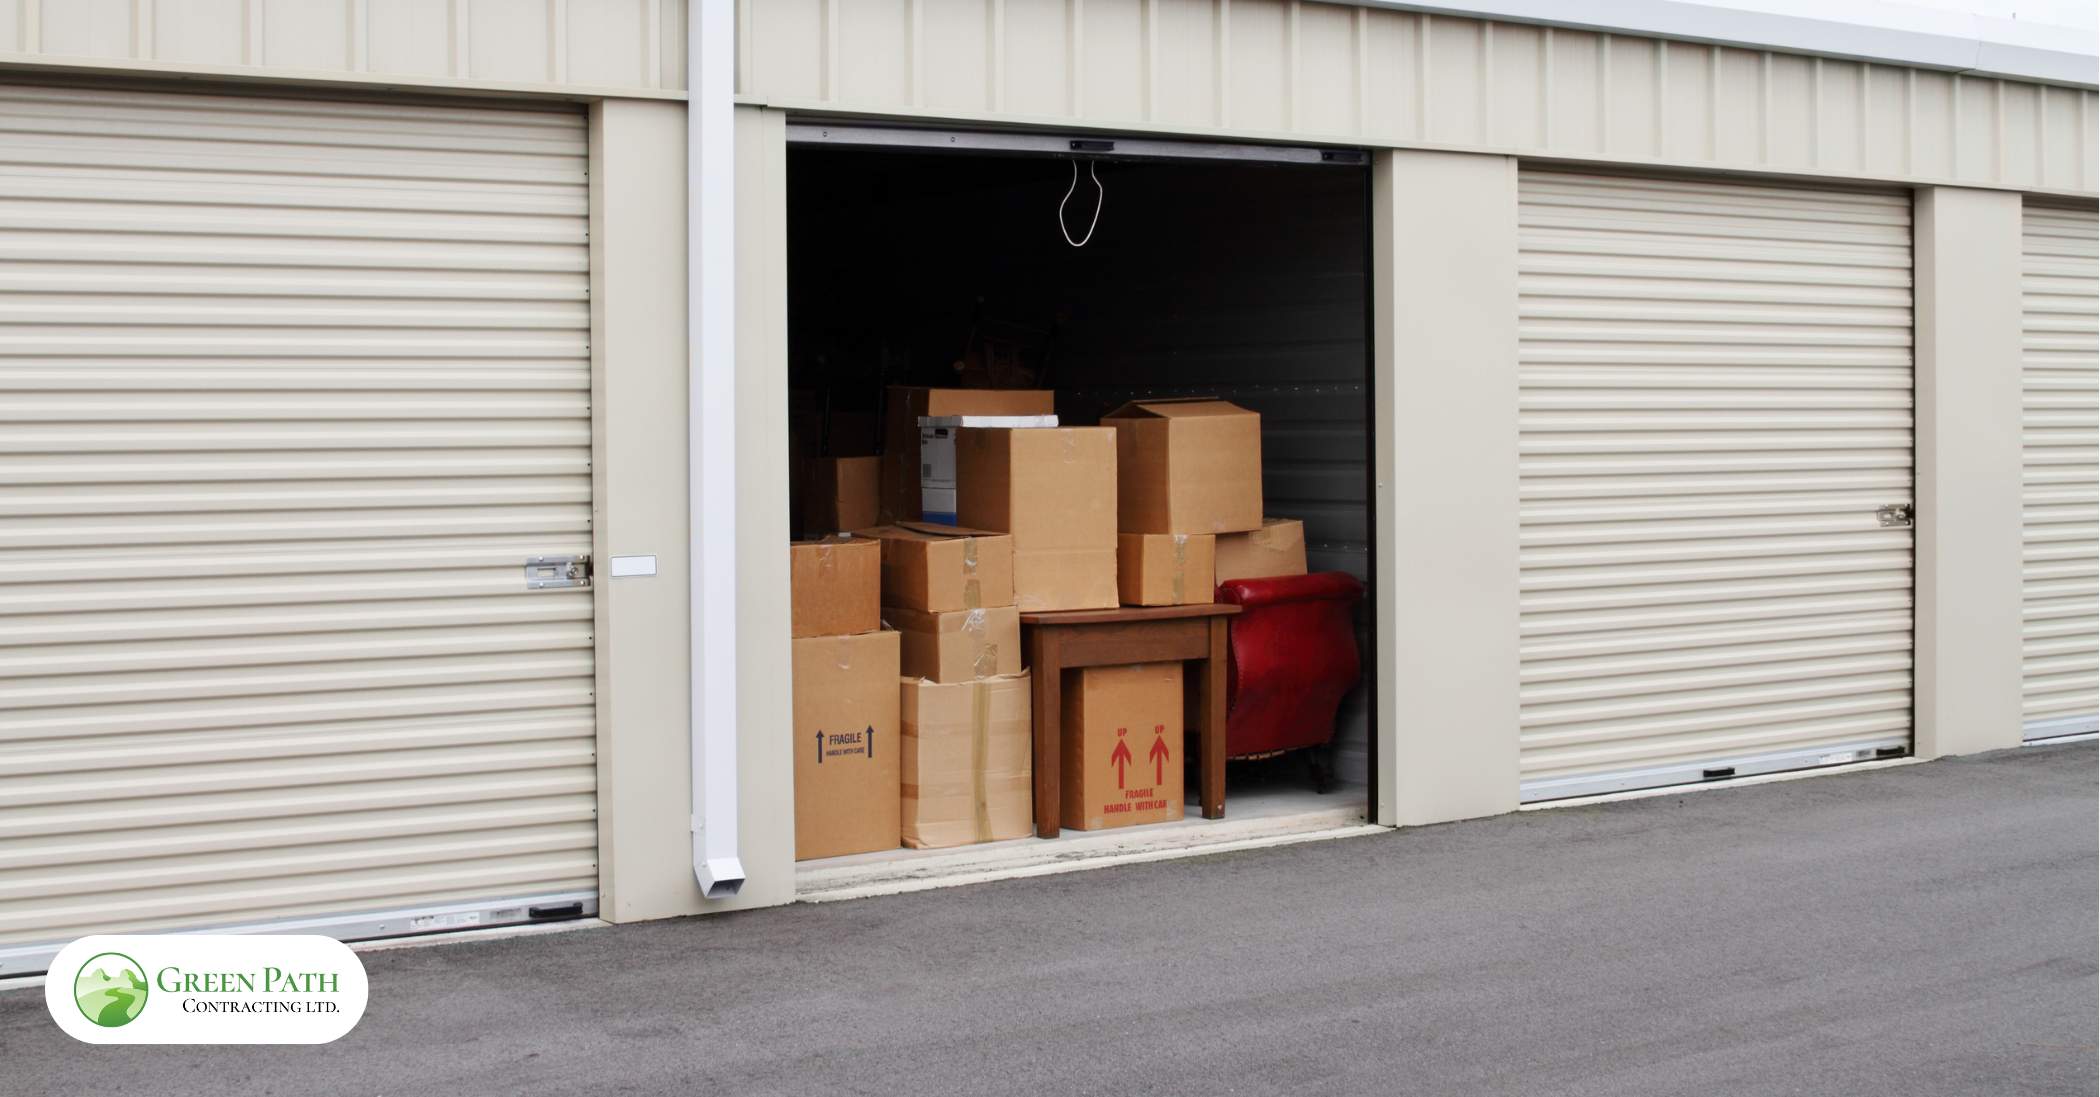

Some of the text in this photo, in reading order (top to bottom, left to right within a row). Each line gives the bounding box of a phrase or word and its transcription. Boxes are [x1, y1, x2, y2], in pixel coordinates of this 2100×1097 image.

[1117, 727, 1127, 737] UP
[829, 732, 862, 745] FRAGILE
[1125, 788, 1153, 799] FRAGILE
[1103, 799, 1167, 814] HANDLE WITH CAR
